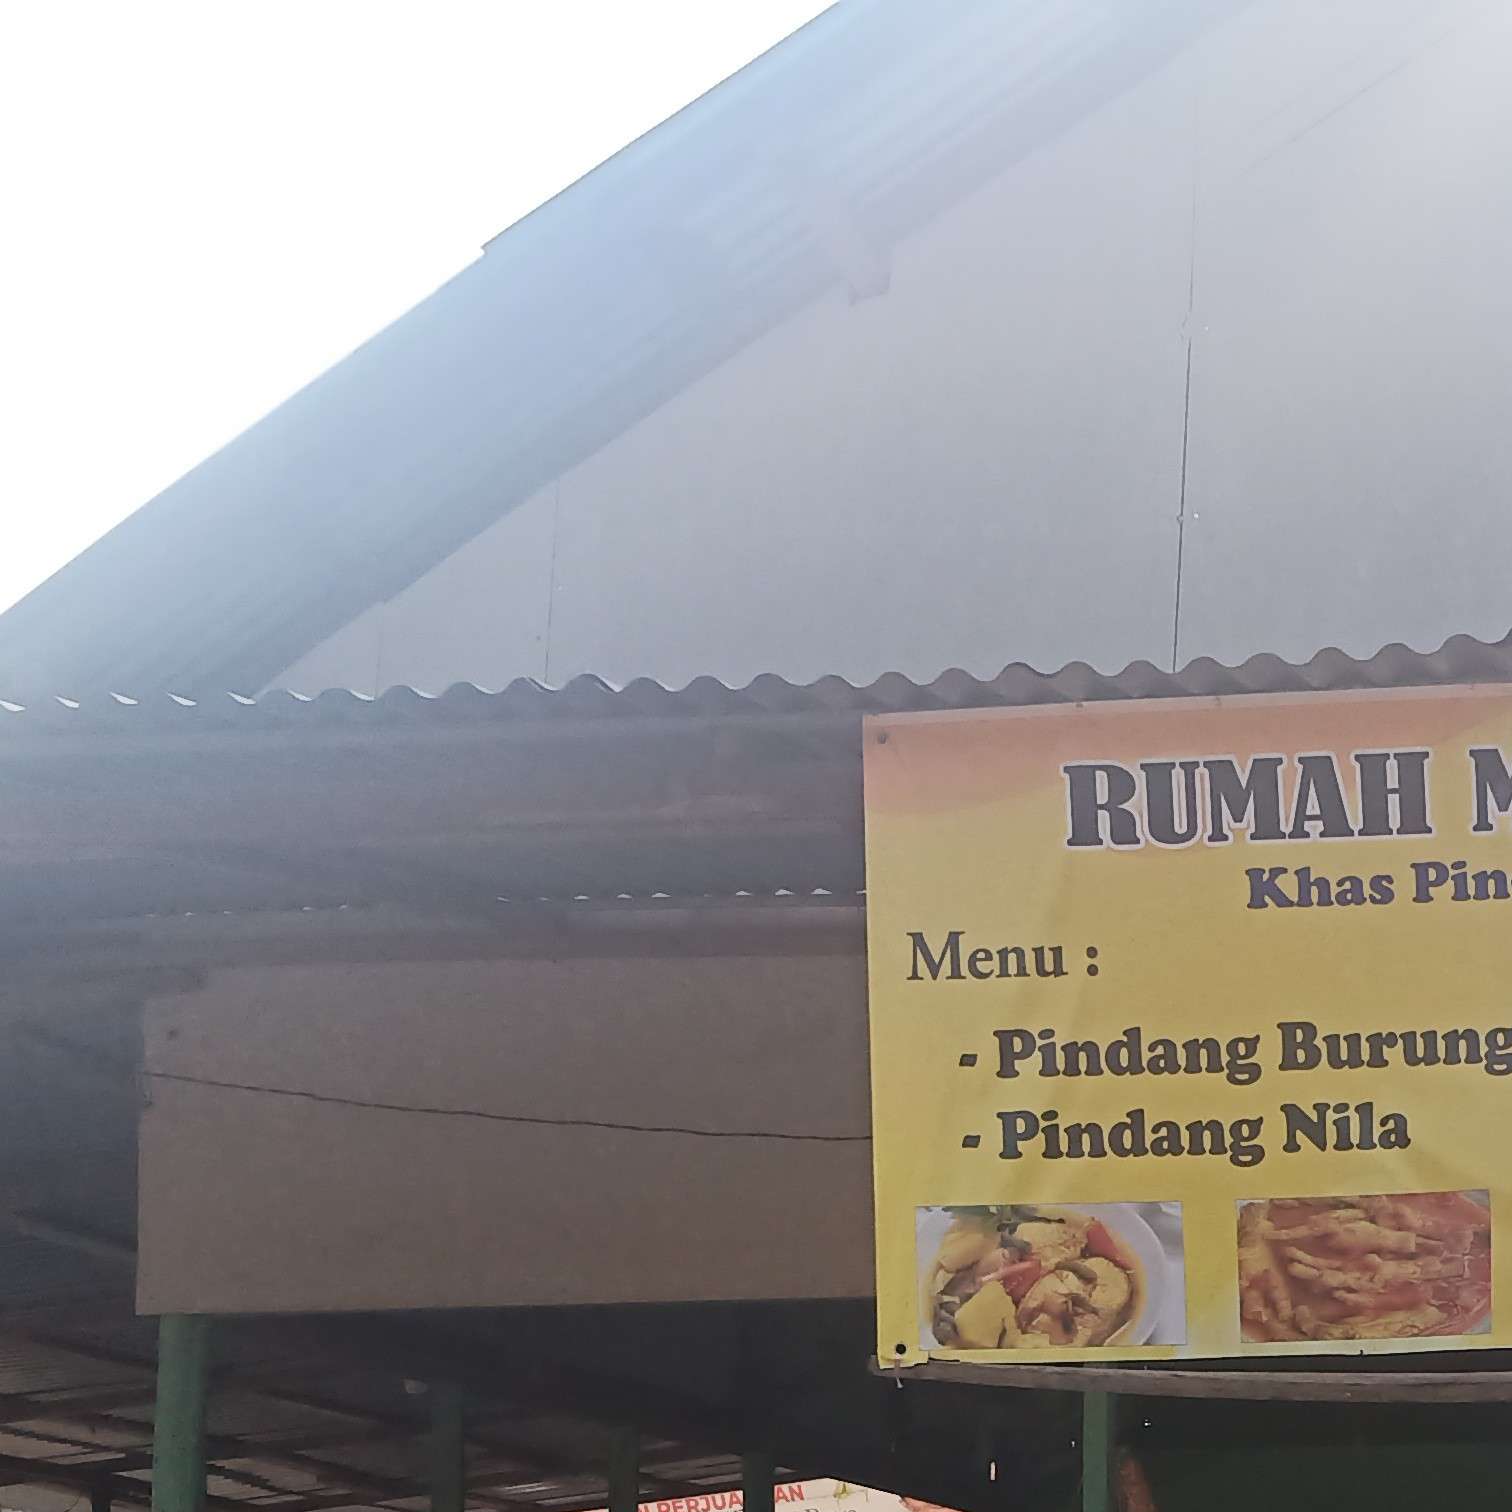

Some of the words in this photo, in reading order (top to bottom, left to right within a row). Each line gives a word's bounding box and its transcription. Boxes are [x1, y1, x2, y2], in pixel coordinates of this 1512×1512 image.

[1063, 750, 1434, 847] RUMAH
[1244, 865, 1396, 910] Khas
[906, 930, 1069, 981] Menu
[992, 1021, 1263, 1086] Pindang
[996, 1103, 1266, 1168] Pindang
[1279, 1101, 1412, 1154] Nila
